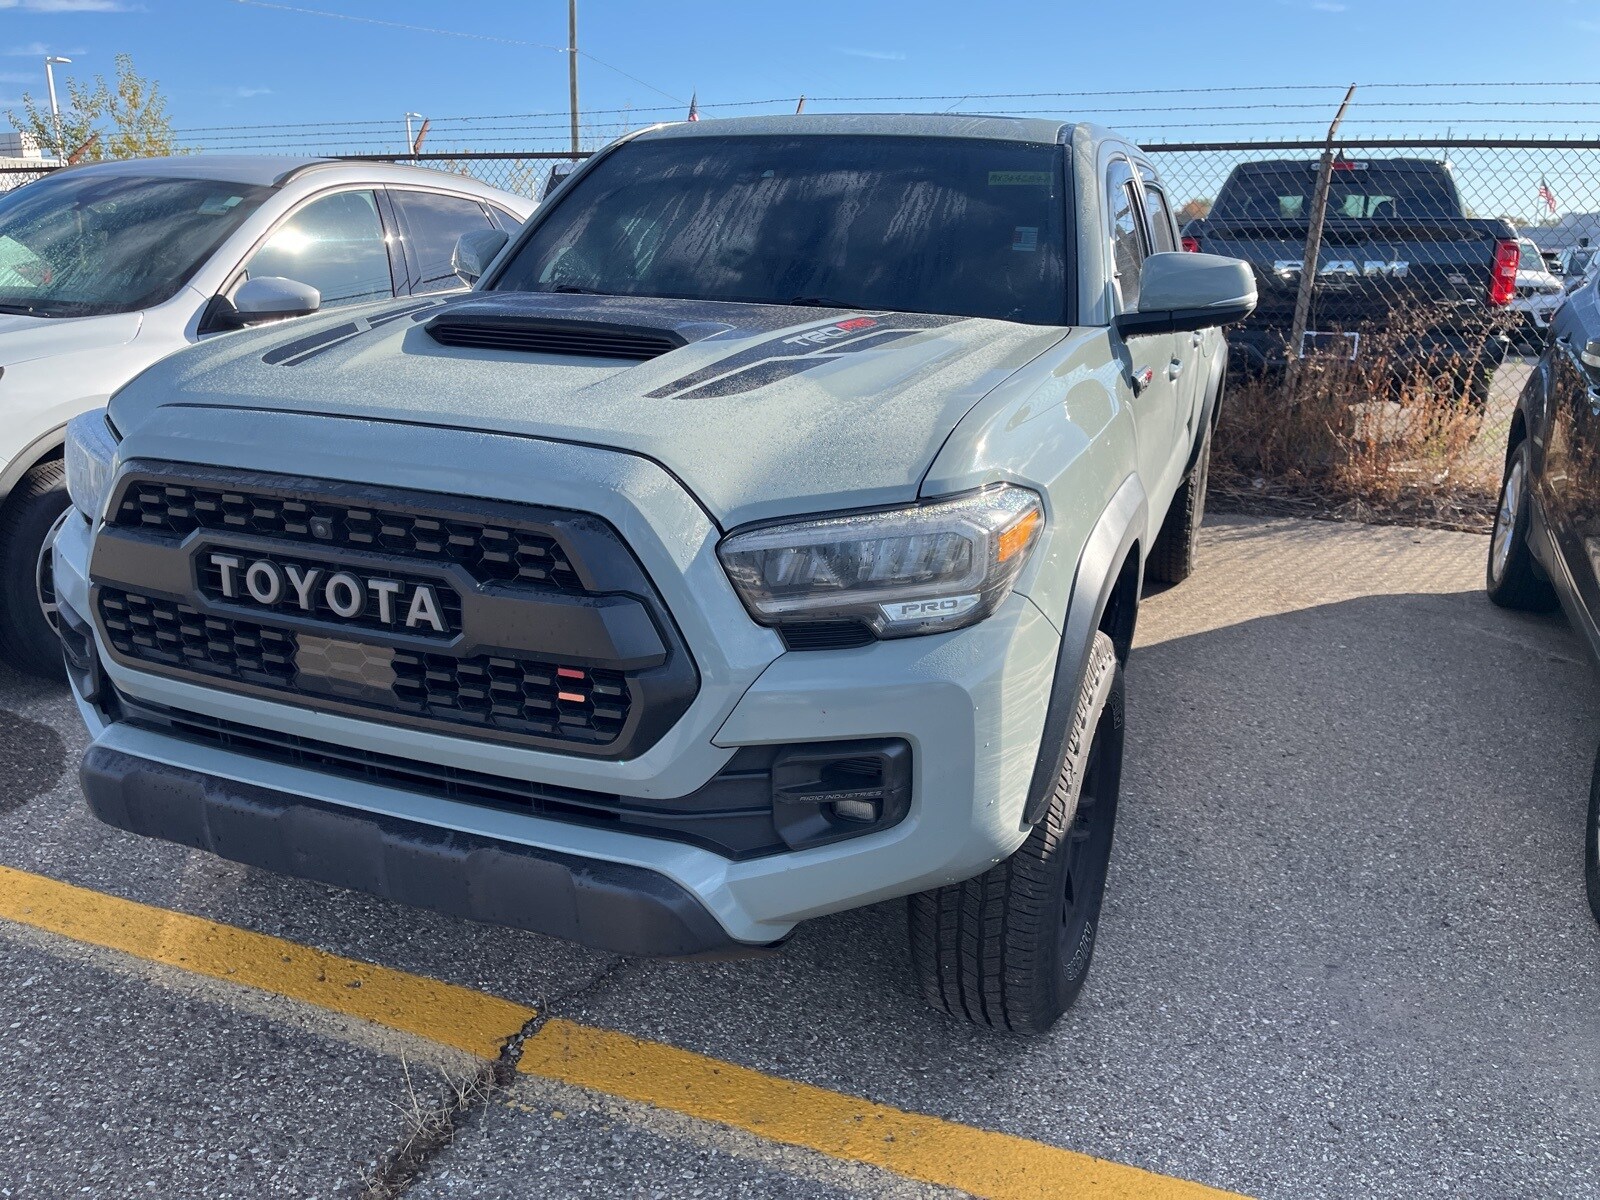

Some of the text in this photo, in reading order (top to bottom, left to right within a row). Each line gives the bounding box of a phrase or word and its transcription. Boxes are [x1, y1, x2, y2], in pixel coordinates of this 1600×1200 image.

[1273, 260, 1409, 278] RAM
[782, 326, 851, 346] TRD
[211, 554, 447, 632] TOYOTA
[901, 600, 958, 615] PRO
[825, 790, 882, 800] INDUSTRIES
